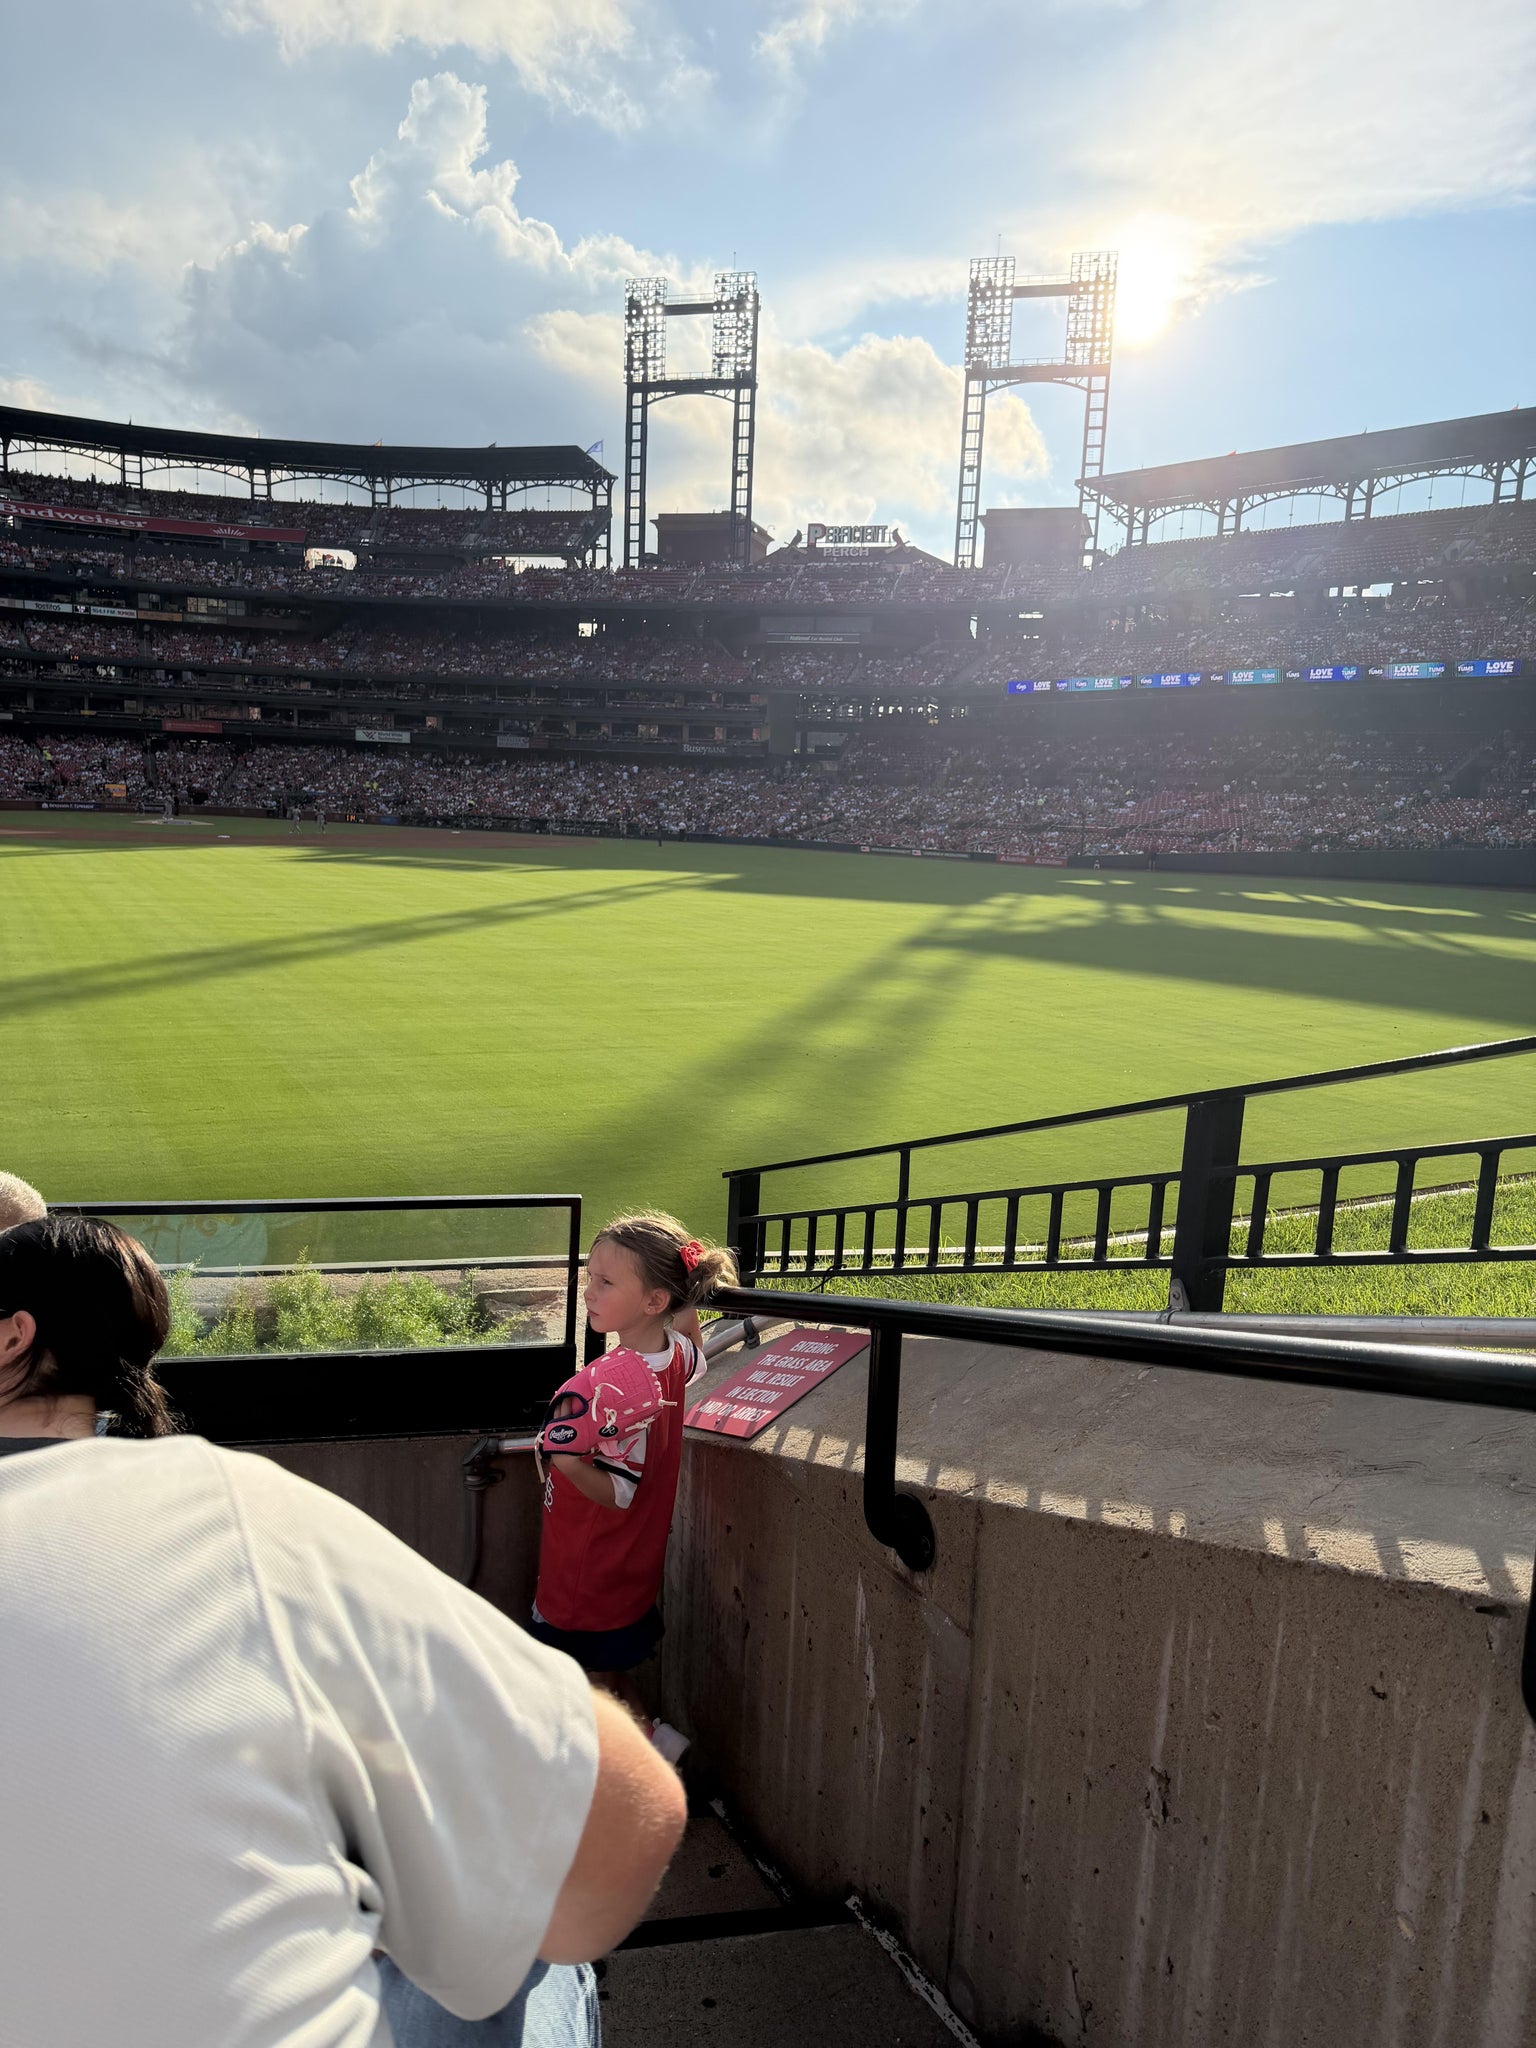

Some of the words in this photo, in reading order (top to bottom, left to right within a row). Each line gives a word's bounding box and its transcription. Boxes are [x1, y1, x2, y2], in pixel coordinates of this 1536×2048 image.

[0, 502, 147, 528] Budweiser
[807, 523, 888, 547] PERFICIENT
[823, 547, 869, 557] PERCH
[1368, 667, 1383, 675] TUMS
[1394, 665, 1419, 673] LOVE
[1458, 664, 1474, 672] TUMS
[1486, 661, 1514, 669] LOVE
[1232, 671, 1254, 679] LOVE
[789, 1340, 839, 1354] ENTERING
[757, 1354, 780, 1366] THE
[777, 1356, 807, 1369] GRASS
[804, 1358, 835, 1373] AREA
[746, 1370, 772, 1383] WILL
[769, 1373, 806, 1387] RESULT
[725, 1386, 740, 1398] IN
[737, 1387, 783, 1404] EJECTION
[696, 1400, 737, 1417] AND/OR
[730, 1405, 772, 1422] ARREST
